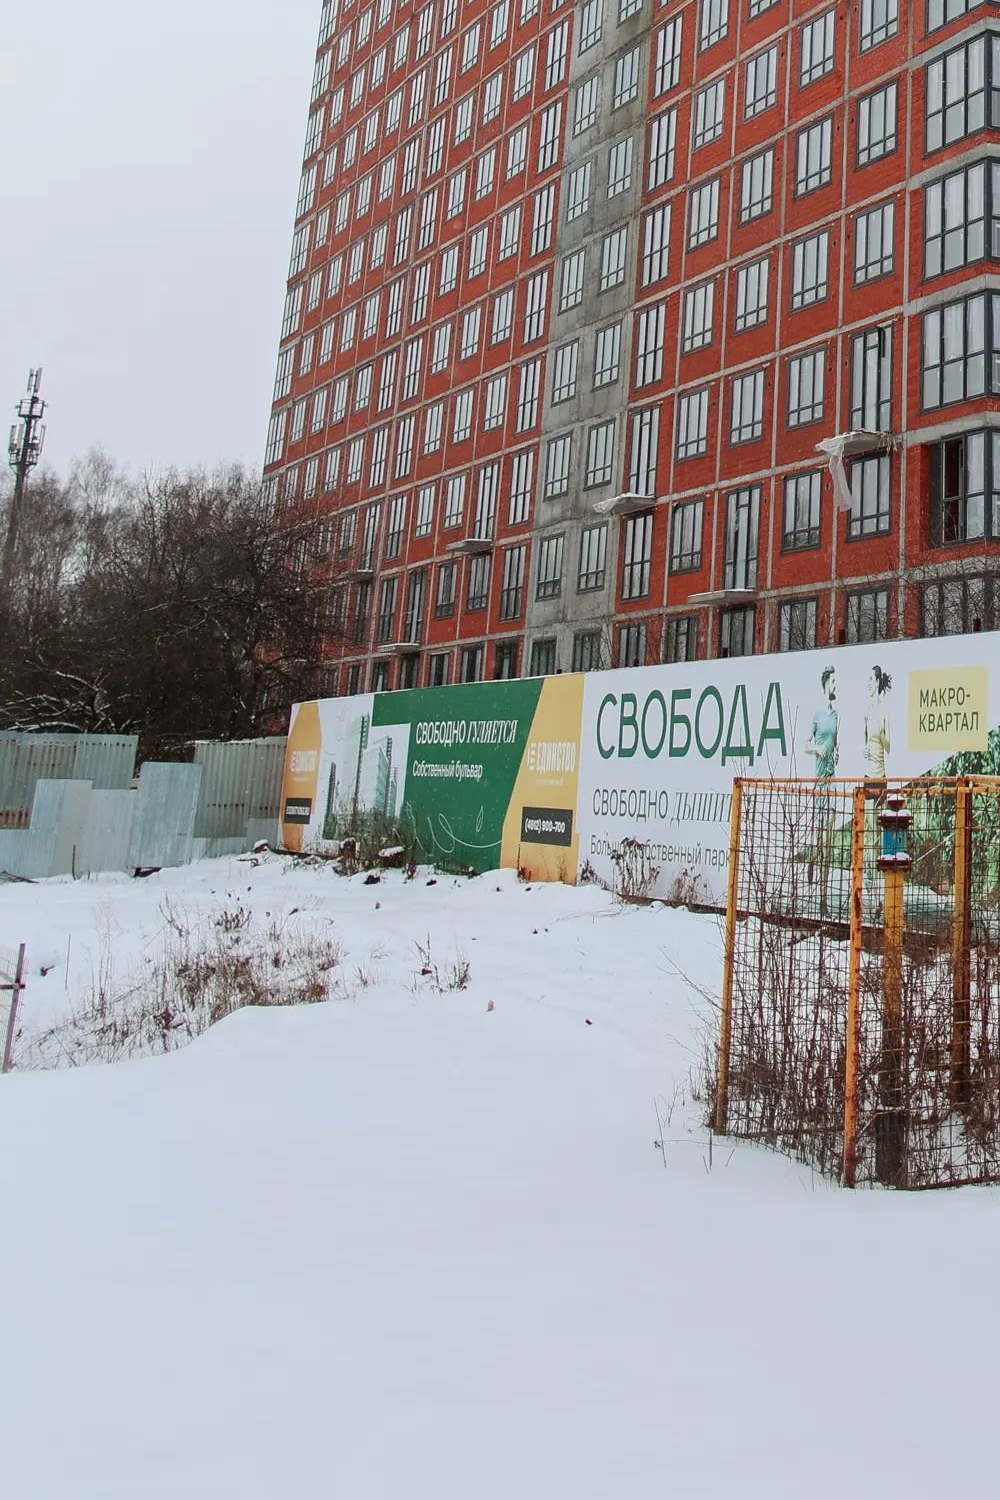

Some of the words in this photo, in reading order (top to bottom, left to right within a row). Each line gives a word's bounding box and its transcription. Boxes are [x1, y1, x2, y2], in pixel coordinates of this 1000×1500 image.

[919, 687, 971, 708] МАКРО-
[415, 720, 467, 748] СВОБОДНО
[596, 682, 787, 767] СВОБОДА
[919, 711, 979, 733] КВАРТАЛ
[536, 742, 577, 775] ЕДИНСТВО
[412, 760, 455, 777] Собственный
[455, 760, 483, 783] бульвар
[592, 788, 669, 823] СВОБОДНО
[541, 820, 566, 834] 900-700
